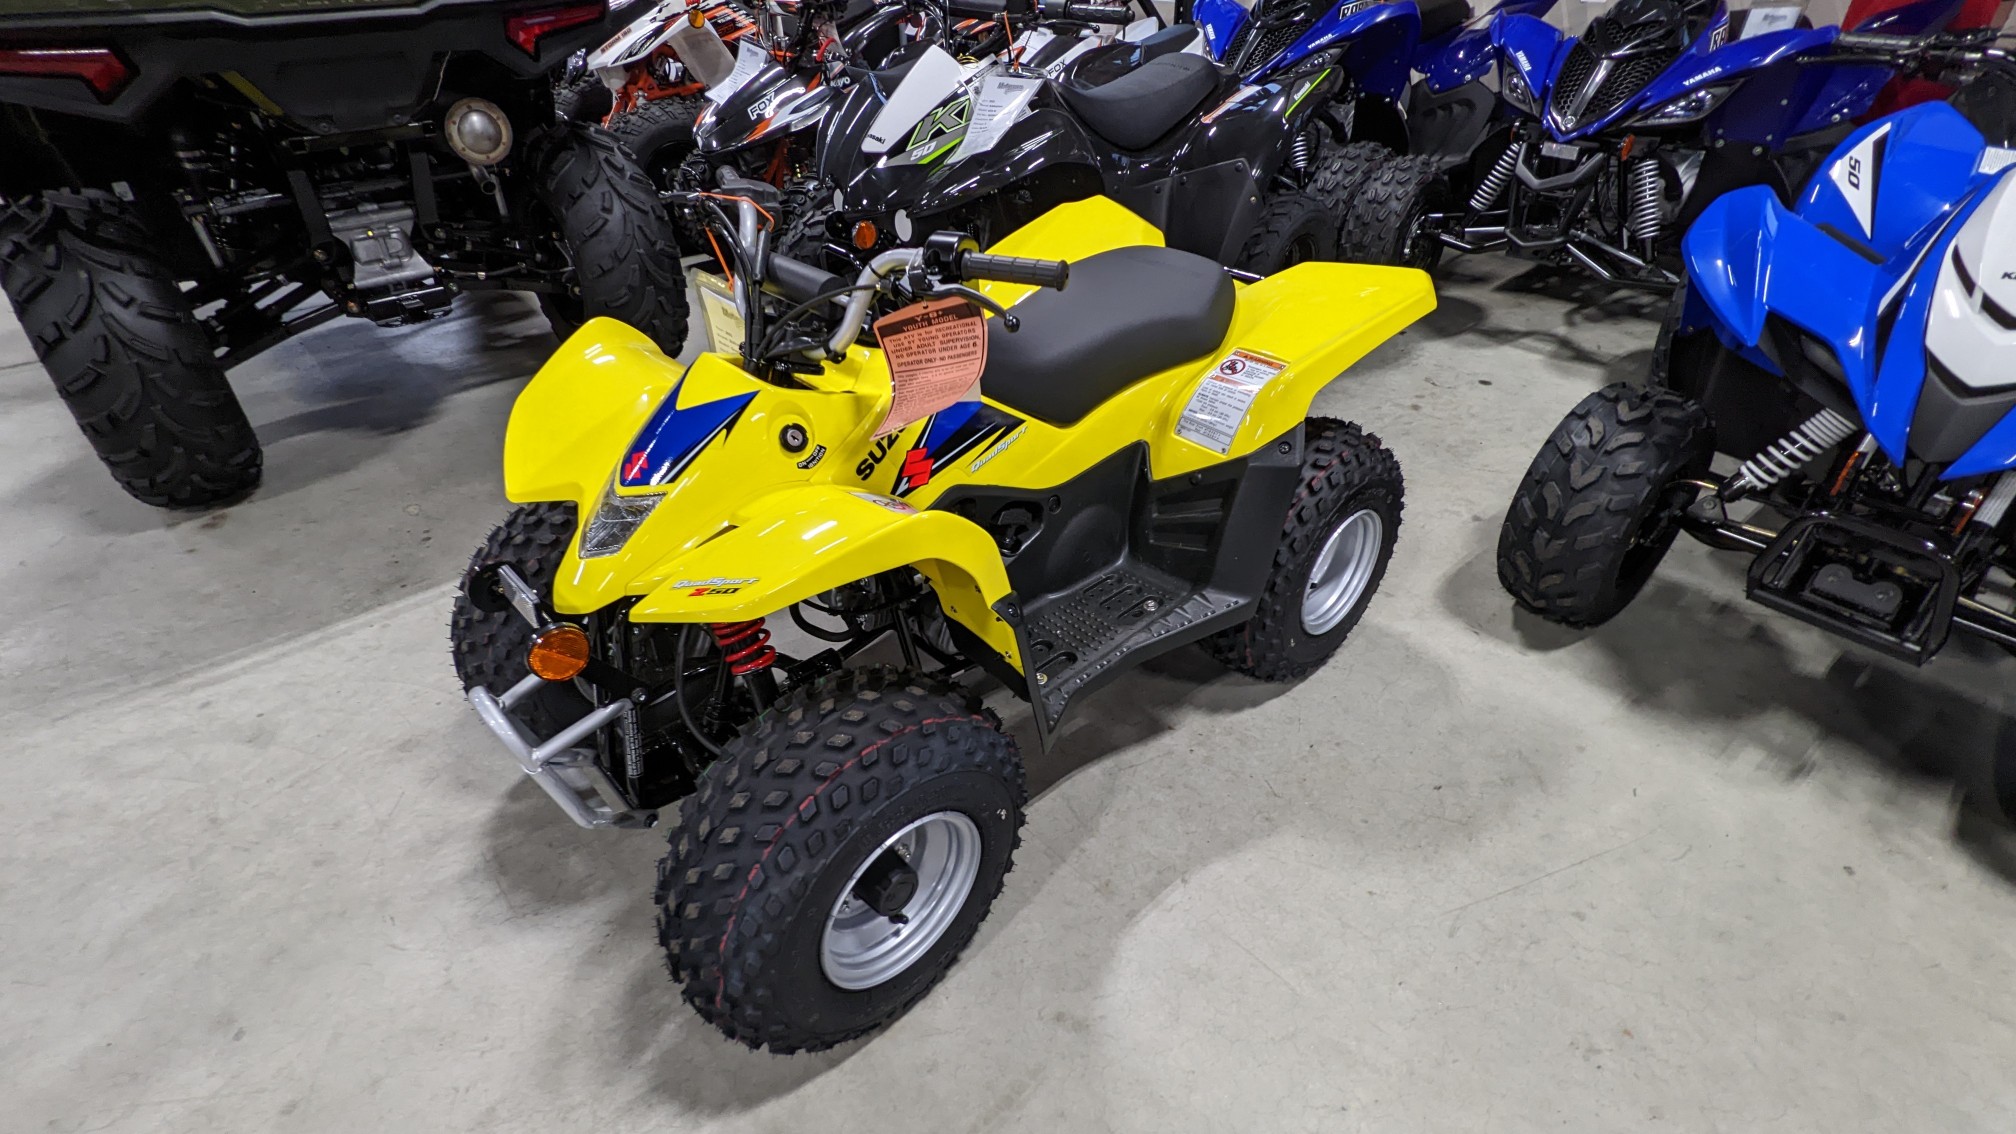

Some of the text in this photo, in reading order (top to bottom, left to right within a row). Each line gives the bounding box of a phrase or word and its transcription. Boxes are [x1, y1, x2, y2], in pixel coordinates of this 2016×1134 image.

[1308, 33, 1333, 49] YAMAHA
[1047, 59, 1067, 78] FOX
[1515, 49, 1532, 72] YAMAHA
[1682, 66, 1723, 87] YAMAHA
[748, 91, 776, 121] FOX
[866, 133, 886, 144] asaki
[910, 141, 937, 161] 50
[1847, 156, 1861, 191] 50
[902, 314, 958, 332] YOUTH MODEL
[904, 333, 915, 341] ATV
[935, 321, 978, 333] RECREATIONAL
[918, 335, 939, 343] YOUNG
[941, 328, 976, 339] OPERATORS
[890, 345, 913, 355] UNDER
[916, 341, 936, 350] ADULT
[906, 348, 937, 358] OPERATOR
[938, 345, 958, 353] UNDER
[896, 359, 923, 368] OPERATOR
[947, 350, 977, 360] PASSENGERS
[855, 426, 907, 482] SUZ
[971, 425, 1028, 474] QuadSport
[672, 576, 760, 590] QuadSport
[687, 587, 742, 597] Z50
